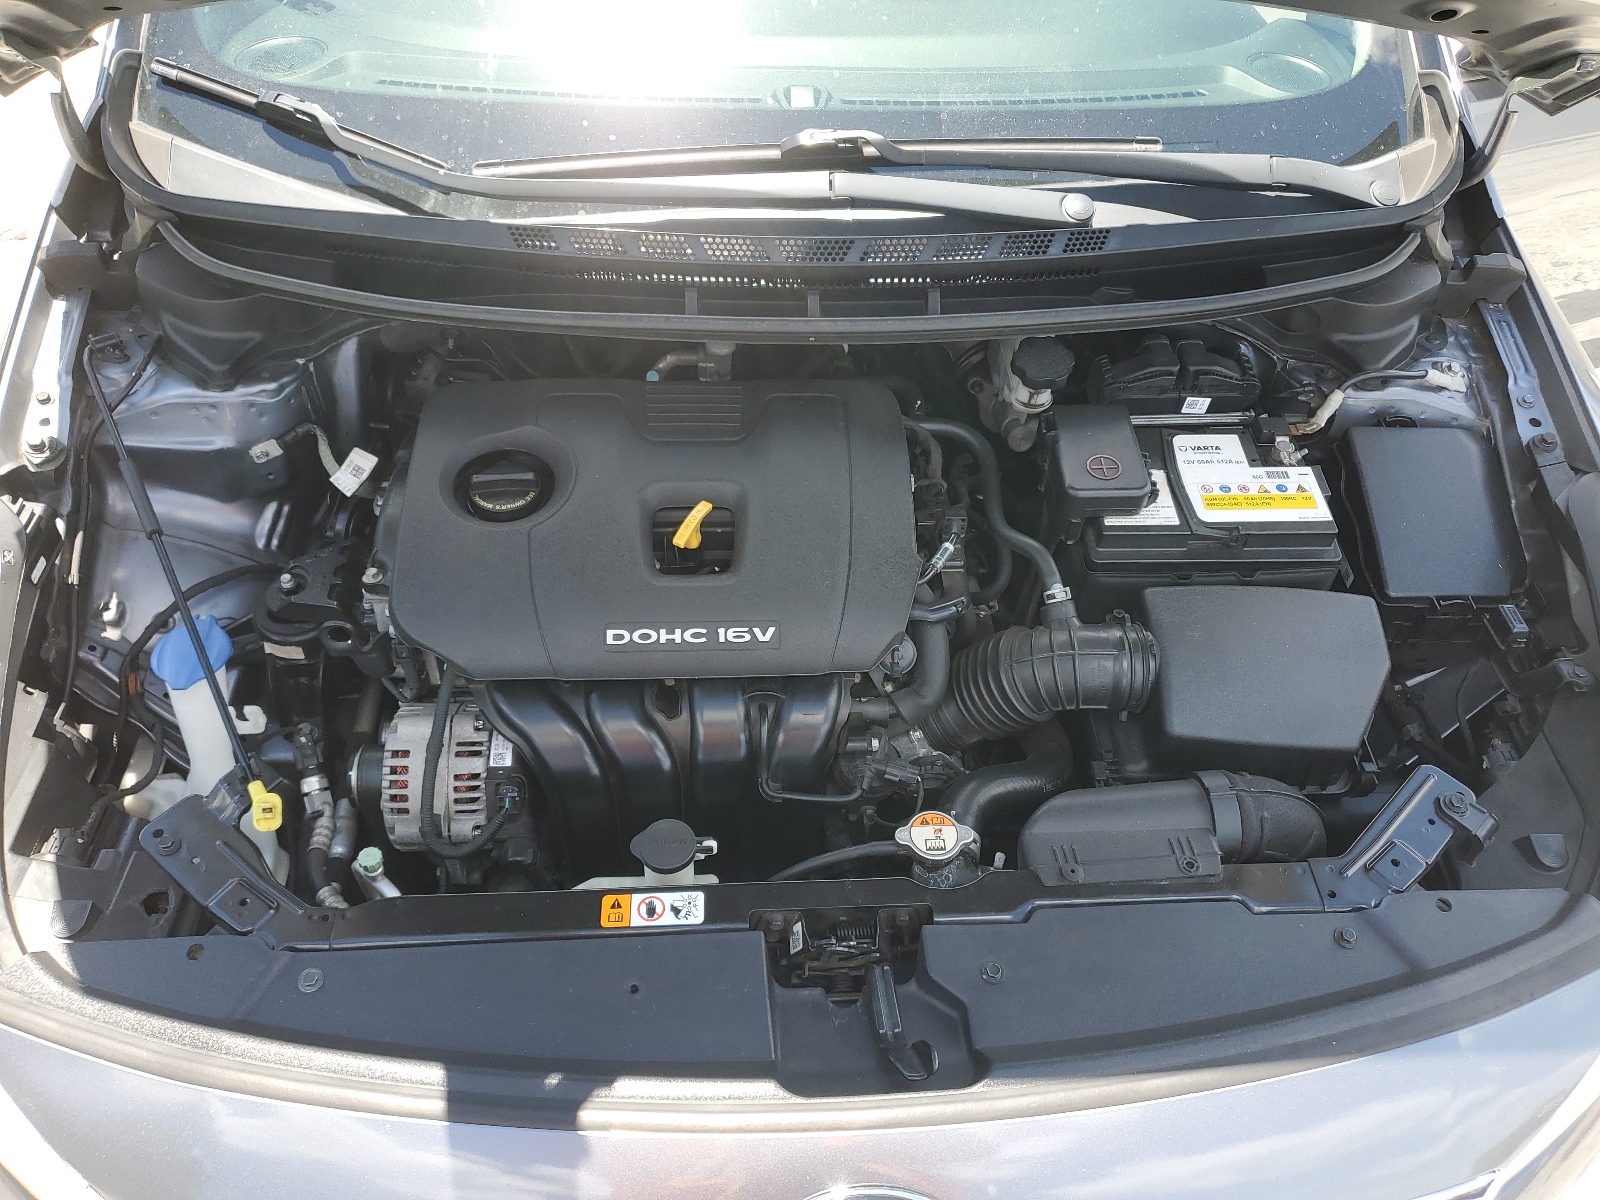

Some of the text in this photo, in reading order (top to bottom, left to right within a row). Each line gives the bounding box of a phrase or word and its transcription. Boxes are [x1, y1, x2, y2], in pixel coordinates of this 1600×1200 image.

[495, 499, 526, 510] OWNER'S
[606, 626, 777, 645] DOHC 16V
